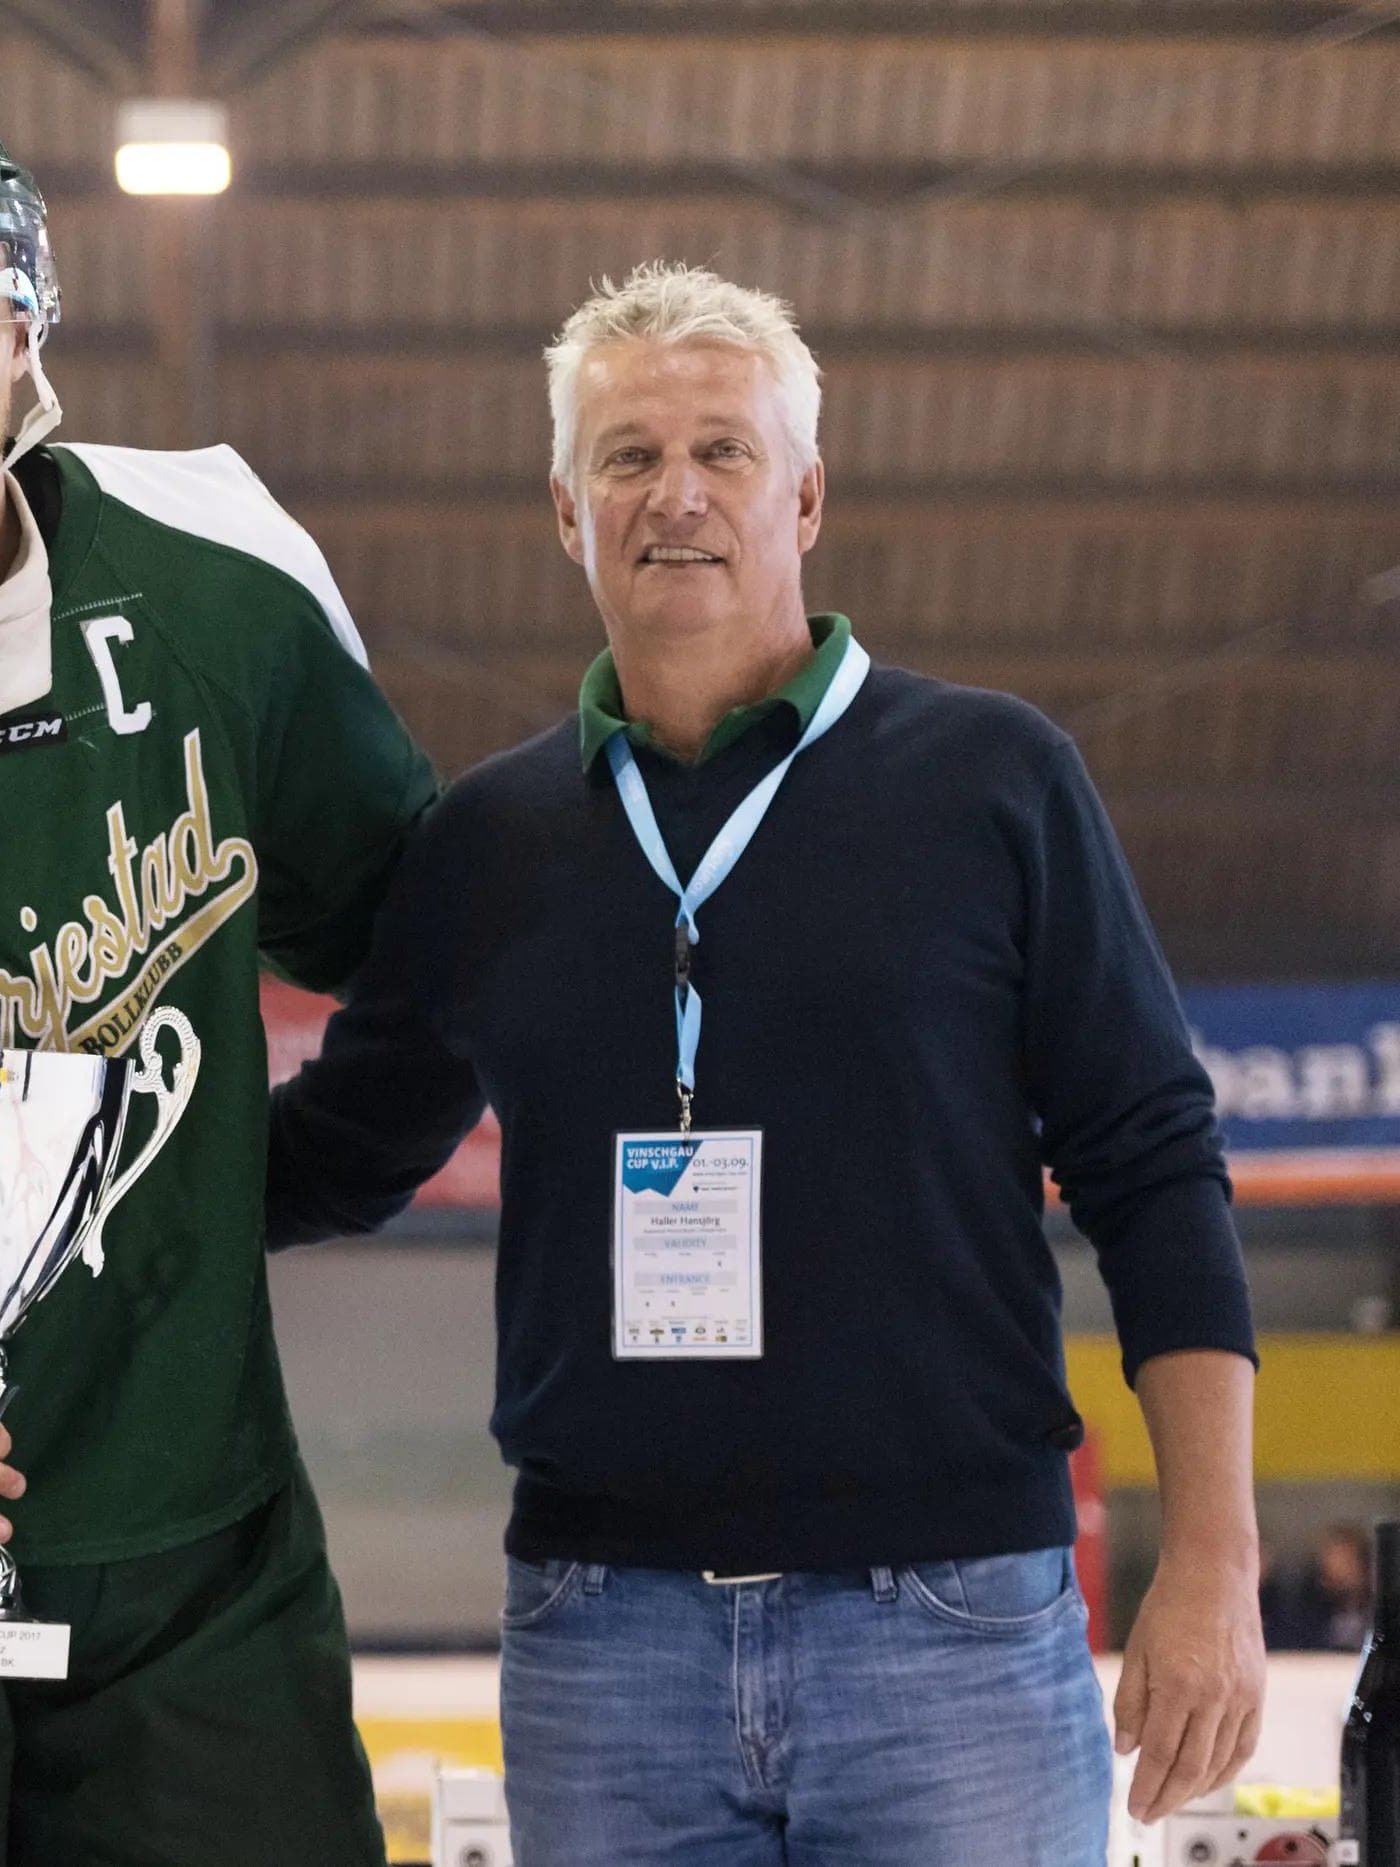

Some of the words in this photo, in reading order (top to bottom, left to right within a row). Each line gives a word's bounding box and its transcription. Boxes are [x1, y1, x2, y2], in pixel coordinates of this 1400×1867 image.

[82, 615, 153, 735] C
[78, 941, 184, 1056] BOLLKLUBB
[626, 1146, 694, 1158] VINSCHGAU
[626, 1158, 650, 1170] CUP
[18, 1631, 41, 1641] 2017
